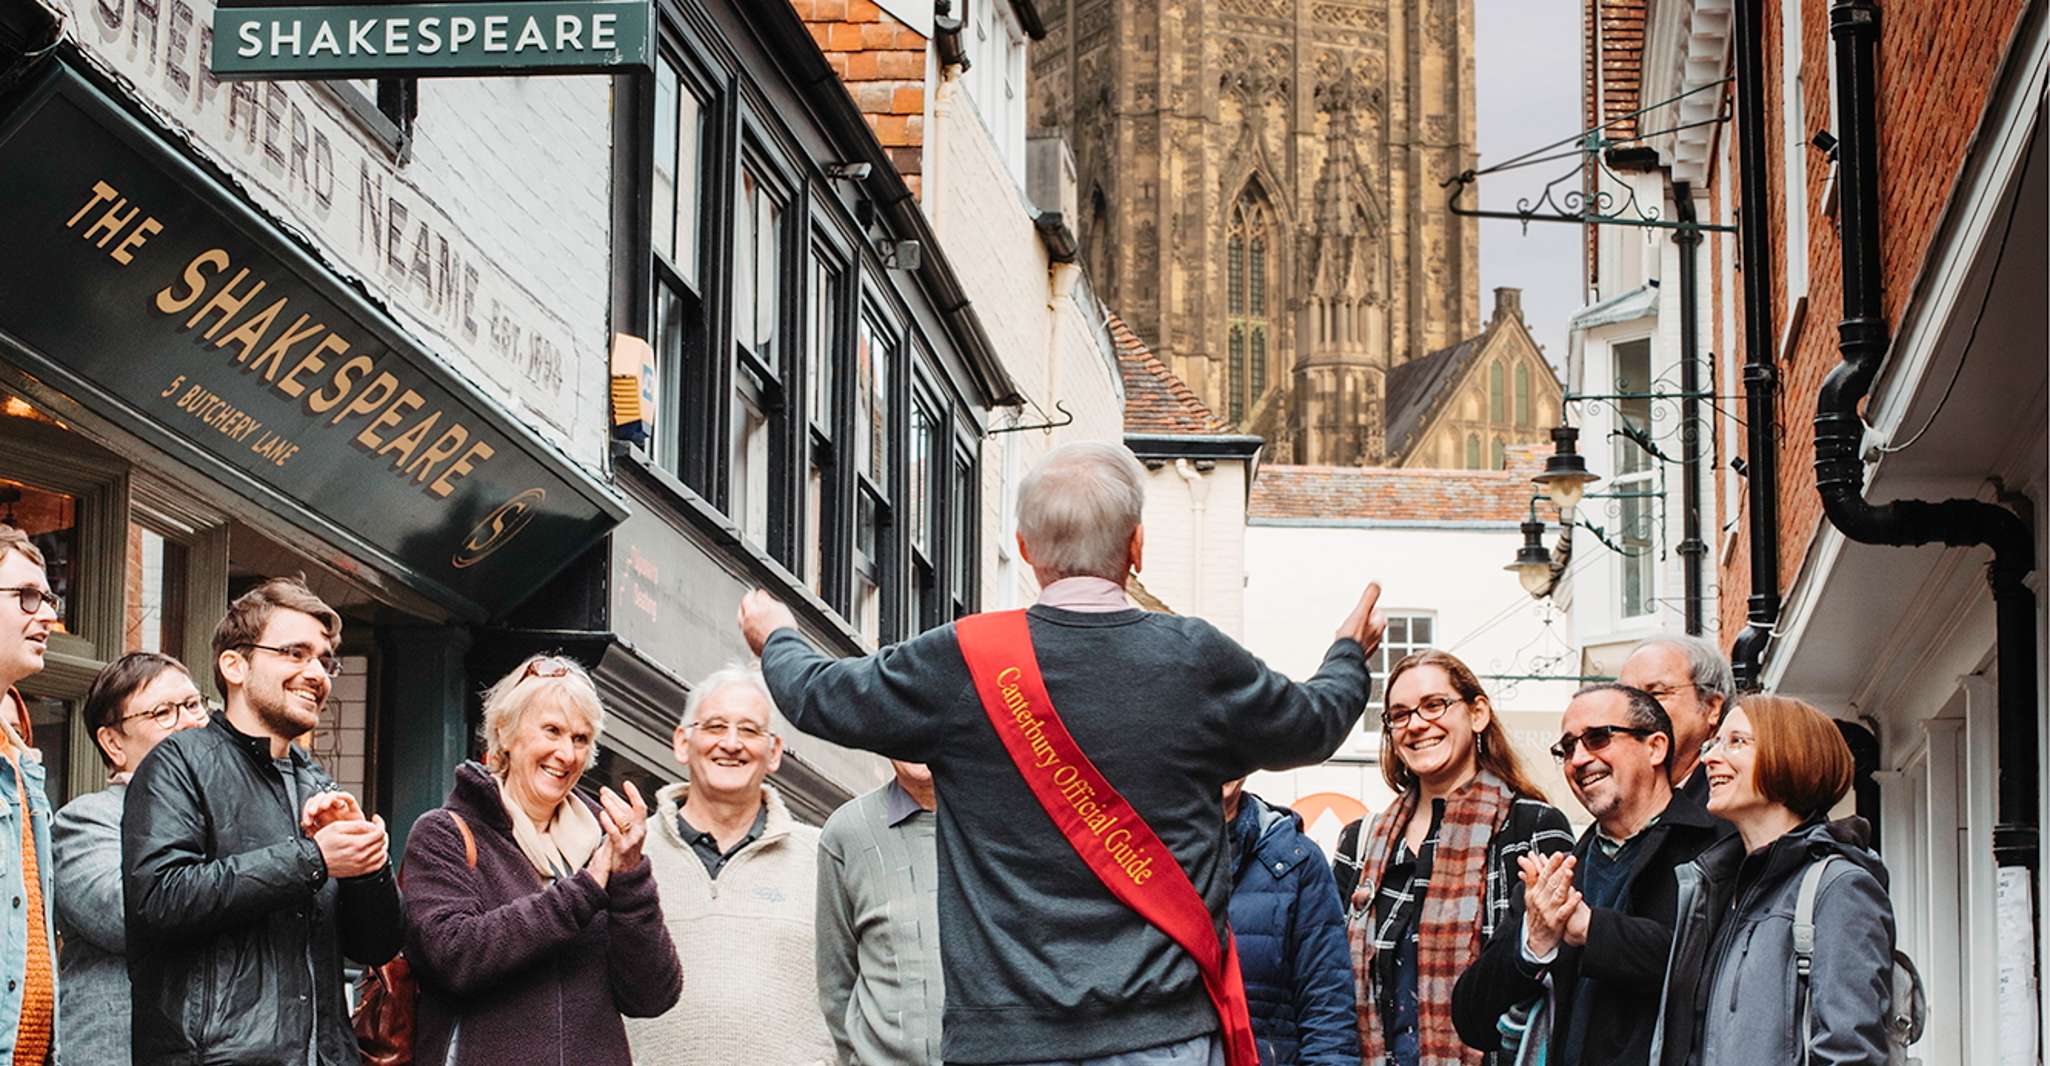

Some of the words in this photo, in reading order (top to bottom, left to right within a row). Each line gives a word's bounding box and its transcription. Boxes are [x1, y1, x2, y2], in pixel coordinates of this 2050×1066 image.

[237, 13, 618, 57] SHAKESPEARE
[66, 180, 164, 266] THE
[155, 248, 496, 498] SHAKESPEARE
[359, 157, 479, 341] NEAME
[489, 297, 523, 364] EST.
[161, 375, 186, 398] 5
[177, 385, 261, 442] BUTCHERY
[251, 430, 300, 466] LANE
[996, 666, 1060, 768] Canterbury
[1053, 765, 1118, 836] Official
[1104, 829, 1153, 885] Guide
